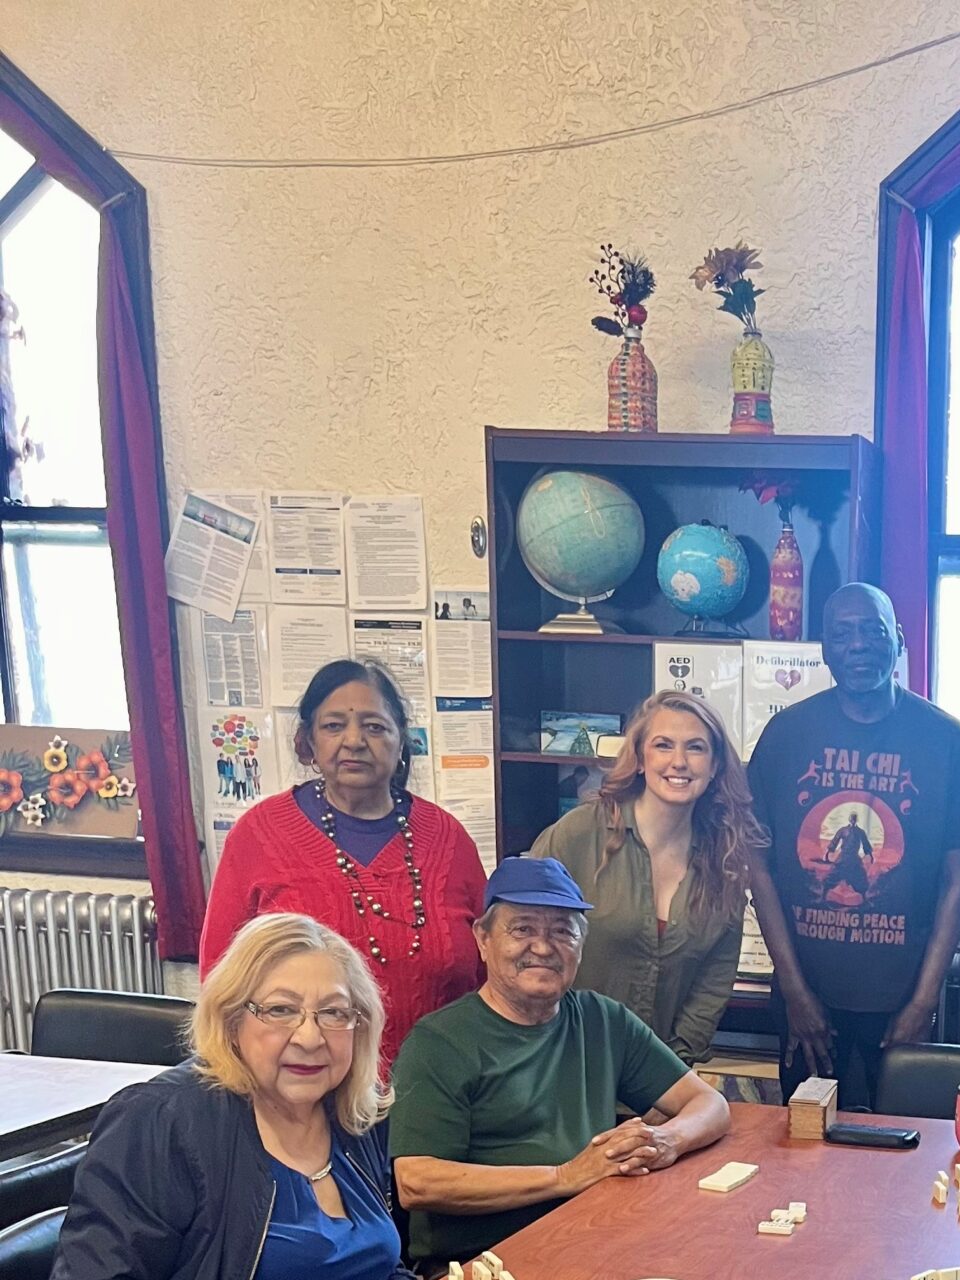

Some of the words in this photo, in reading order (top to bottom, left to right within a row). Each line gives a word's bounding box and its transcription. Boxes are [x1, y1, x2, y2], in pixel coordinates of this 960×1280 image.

[669, 657, 691, 665] AED
[756, 655, 821, 669] Defibrillator
[824, 747, 859, 773] TAI
[866, 752, 901, 777] CHI
[822, 772, 835, 787] IS
[840, 773, 864, 789] THE
[868, 776, 897, 792] ART
[805, 908, 860, 928] FINDING
[863, 913, 905, 930] PEACE
[795, 920, 846, 942] ROUGH
[850, 928, 905, 945] MOTION
